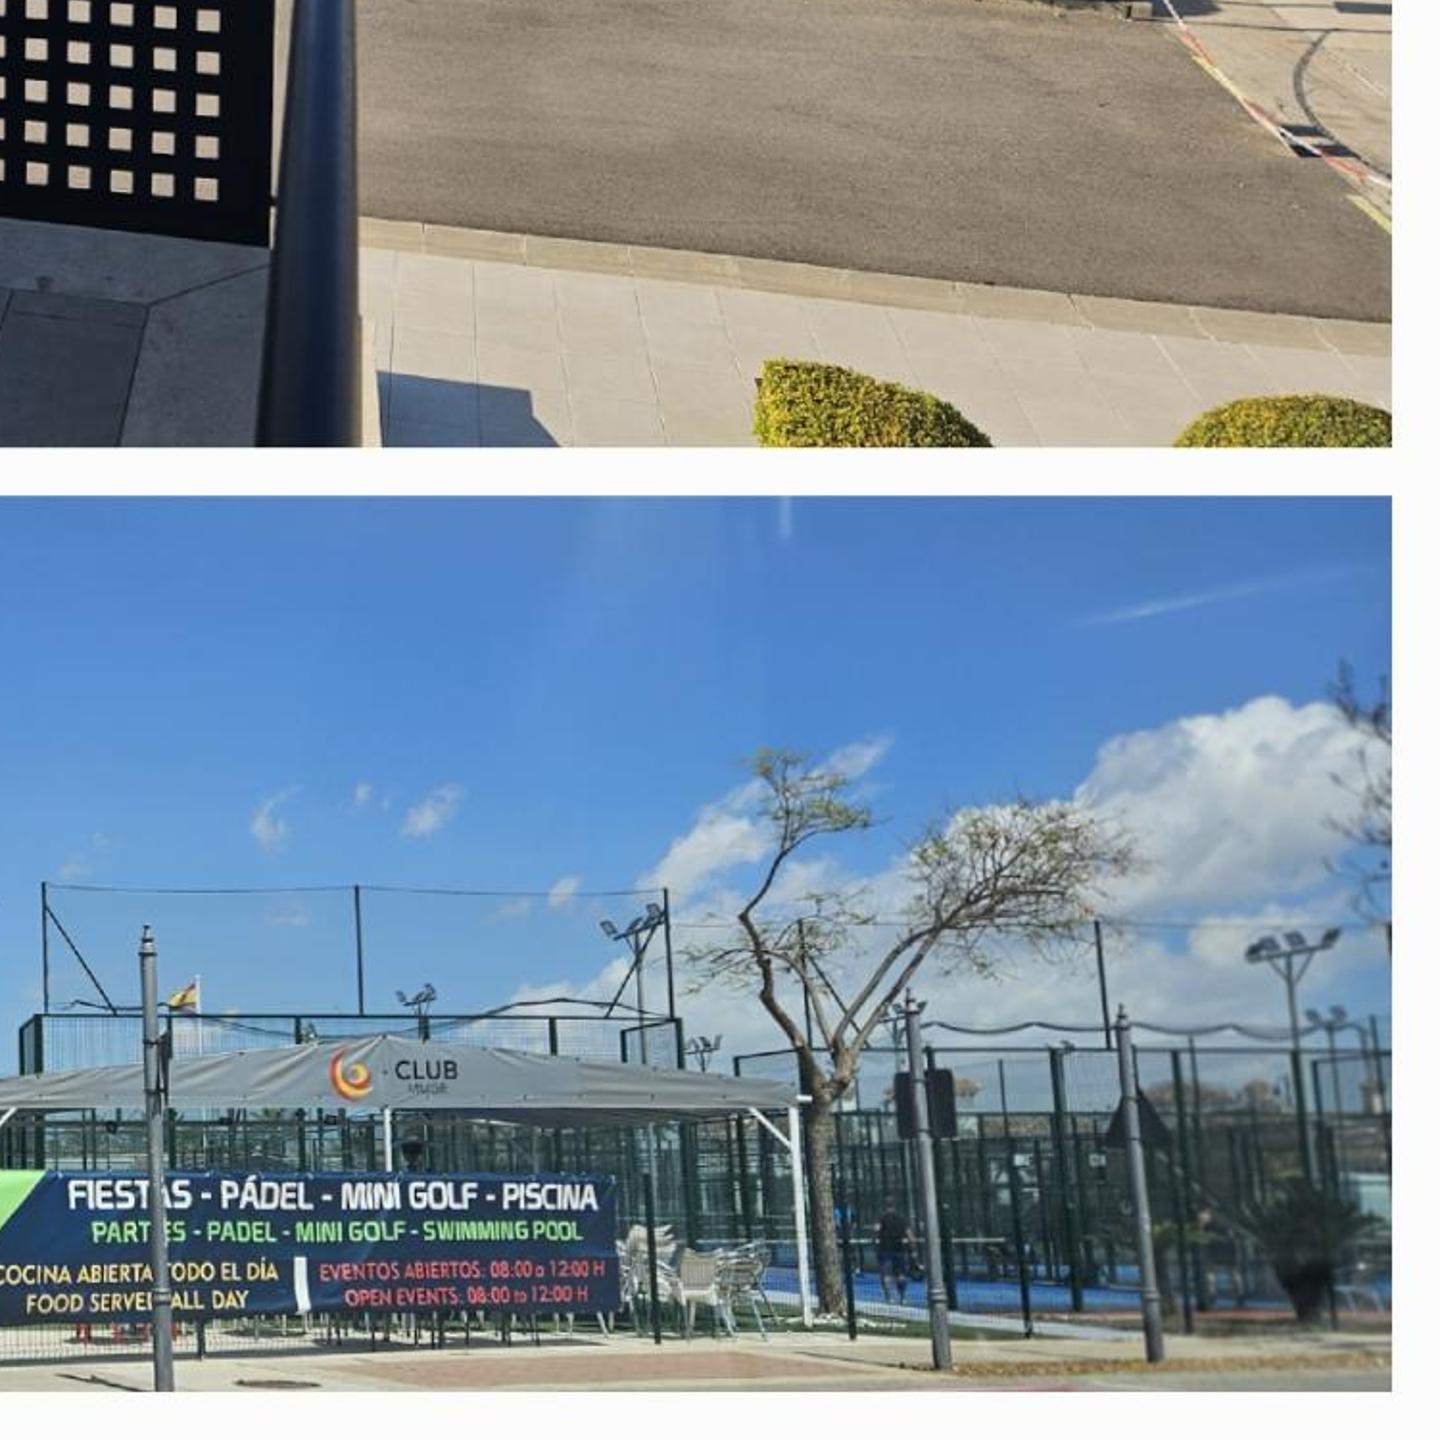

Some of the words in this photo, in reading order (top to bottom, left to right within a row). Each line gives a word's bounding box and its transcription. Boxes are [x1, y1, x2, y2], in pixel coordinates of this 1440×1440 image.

[395, 1060, 458, 1080] CLUB
[220, 1174, 314, 1210] PÁDEL
[341, 1182, 401, 1210] MINI
[408, 1181, 478, 1210] GOLF
[502, 1183, 599, 1210] PISCINA
[91, 1221, 187, 1243] PARTES
[207, 1222, 277, 1243] PADEL
[295, 1221, 343, 1242] MINI
[348, 1220, 408, 1242] GOLF
[423, 1220, 529, 1241] SWIMMING
[533, 1220, 584, 1241] POOL
[76, 1262, 154, 1283] ABIERTA
[166, 1262, 215, 1282] ODO
[220, 1262, 241, 1281] EL
[247, 1257, 279, 1281] DÍA
[320, 1263, 400, 1282] EVENTOS
[593, 1260, 606, 1276] H
[26, 1293, 84, 1314] FOOD
[170, 1290, 205, 1309] ALL
[212, 1290, 250, 1309] DAY
[344, 1289, 393, 1307] OPEN
[575, 1286, 588, 1302] H
